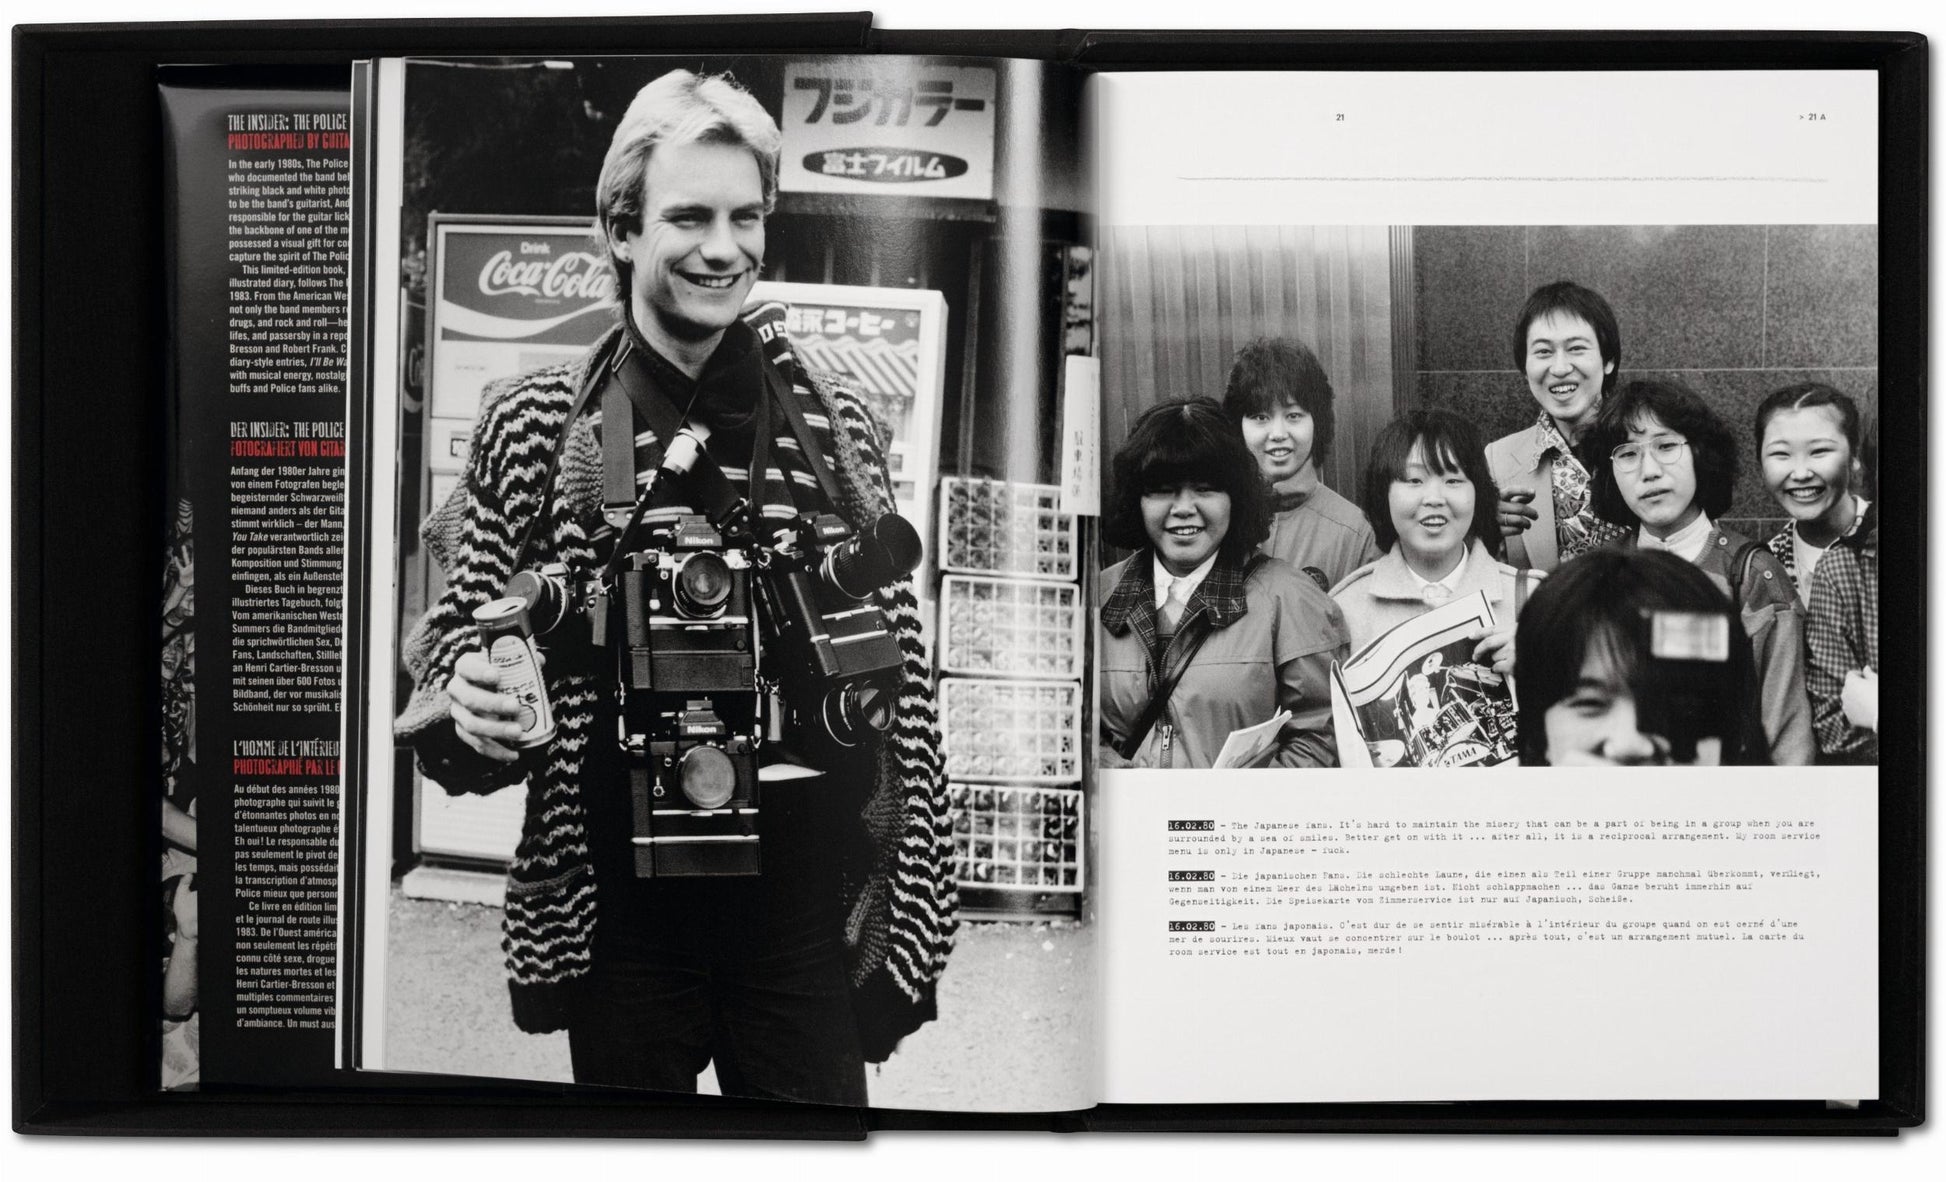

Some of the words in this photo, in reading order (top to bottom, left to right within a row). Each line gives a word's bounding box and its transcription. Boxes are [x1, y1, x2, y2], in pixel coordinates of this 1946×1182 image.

[794, 77, 985, 127] フジカラー
[228, 114, 245, 130] THE
[293, 114, 310, 130] THE
[1336, 113, 1344, 121] 21
[1808, 113, 1816, 121] 21
[1820, 113, 1826, 121] A
[307, 133, 319, 149] BY
[228, 159, 237, 169] In
[239, 159, 252, 169] the
[254, 159, 275, 170] early
[278, 159, 304, 169] 1980s,
[306, 158, 321, 168] The
[323, 158, 348, 168] Police
[228, 172, 245, 183] who
[247, 172, 297, 182] documented
[299, 172, 313, 182] the
[315, 172, 335, 182] band
[228, 185, 260, 197] striking
[262, 185, 284, 196] black
[287, 185, 302, 195] and
[304, 185, 326, 195] white
[228, 199, 237, 209] to
[239, 198, 250, 209] be
[251, 198, 265, 209] the
[296, 198, 333, 210] guitarist,
[229, 212, 276, 223] responsible
[278, 212, 290, 222] for
[292, 212, 306, 221] the
[308, 212, 332, 223] guitar
[229, 225, 242, 235] the
[244, 225, 284, 235] backbone
[286, 225, 295, 235] of
[297, 227, 312, 235] one
[314, 225, 322, 234] of
[325, 225, 338, 234] the
[229, 238, 271, 250] possessed
[273, 240, 279, 248] a
[281, 238, 305, 248] visual
[307, 238, 321, 250] gift
[323, 238, 335, 248] for
[520, 241, 551, 254] Drink
[229, 252, 261, 263] capture
[263, 251, 276, 261] the
[279, 251, 300, 263] spirit
[302, 251, 310, 261] of
[312, 251, 327, 261] The
[231, 422, 248, 438] DER
[293, 422, 309, 438] THE
[298, 440, 318, 457] VON
[231, 466, 259, 477] Anfang
[261, 466, 275, 476] der
[278, 466, 306, 476] 1980er
[308, 466, 330, 476] Jahre
[231, 481, 245, 489] von
[248, 479, 273, 489] einem
[275, 479, 320, 491] Fotografen
[231, 492, 288, 504] begeisternder
[822, 526, 845, 535] Nikon
[684, 536, 713, 545] Nikon
[687, 724, 717, 734] Nikon
[278, 740, 288, 756] DE
[1450, 747, 1477, 764] TAMA
[305, 759, 323, 775] PAR
[326, 759, 335, 775] LE
[234, 784, 244, 793] Au
[246, 784, 270, 794] début
[272, 784, 286, 794] des
[288, 784, 318, 794] années
[234, 797, 286, 808] photographe
[288, 798, 301, 808] qui
[303, 798, 325, 807] suivit
[327, 798, 334, 807] le
[289, 811, 317, 822] photos
[1168, 820, 1214, 831] 16.02.80
[1253, 821, 1299, 830] Japanese
[1485, 820, 1519, 828] misery
[1604, 820, 1627, 828] part
[1649, 820, 1679, 829] being
[1746, 819, 1770, 827] when
[1775, 820, 1792, 828] you
[1168, 834, 1225, 842] surrounded
[1231, 834, 1242, 843] by
[1384, 834, 1400, 842] get
[1525, 832, 1547, 840] all,
[1600, 832, 1655, 841] reciprocal
[1662, 832, 1728, 841] arrangement.
[1736, 832, 1745, 841] My
[1781, 832, 1820, 840] service
[1214, 847, 1238, 856] only
[1259, 847, 1304, 855] Japanese
[1168, 870, 1215, 881] 16.02.80
[1168, 920, 1215, 931] 16.02.80
